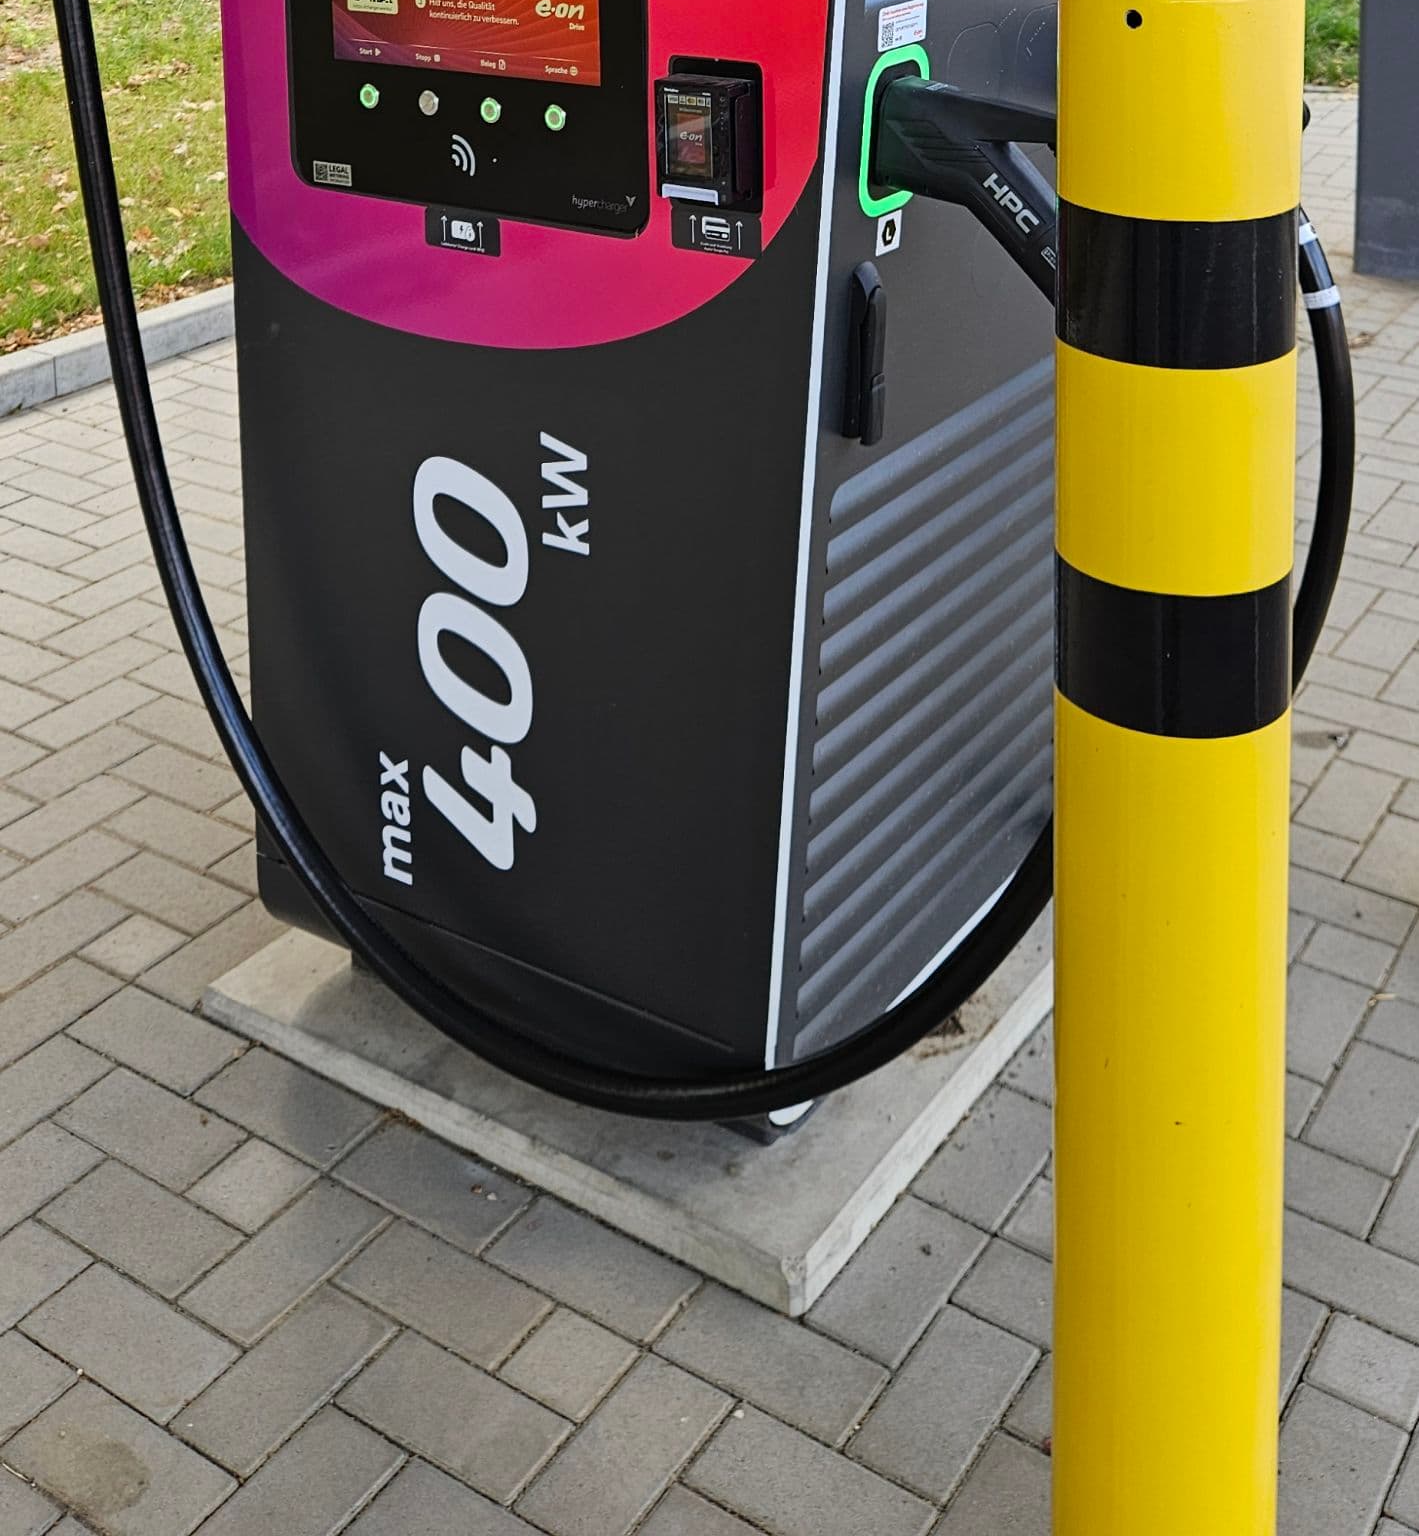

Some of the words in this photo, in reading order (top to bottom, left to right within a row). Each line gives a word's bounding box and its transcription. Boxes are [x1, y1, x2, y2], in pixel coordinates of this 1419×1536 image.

[442, 0, 456, 9] uns,
[456, 0, 467, 9] die
[468, 0, 496, 11] Qualität
[473, 14, 481, 22] zu
[359, 47, 373, 56] Start
[545, 64, 568, 76] Sprache
[571, 194, 629, 215] hypercharger
[982, 172, 1040, 235] HPC
[539, 430, 591, 556] kW
[412, 455, 537, 872] 400
[378, 750, 414, 886] max
